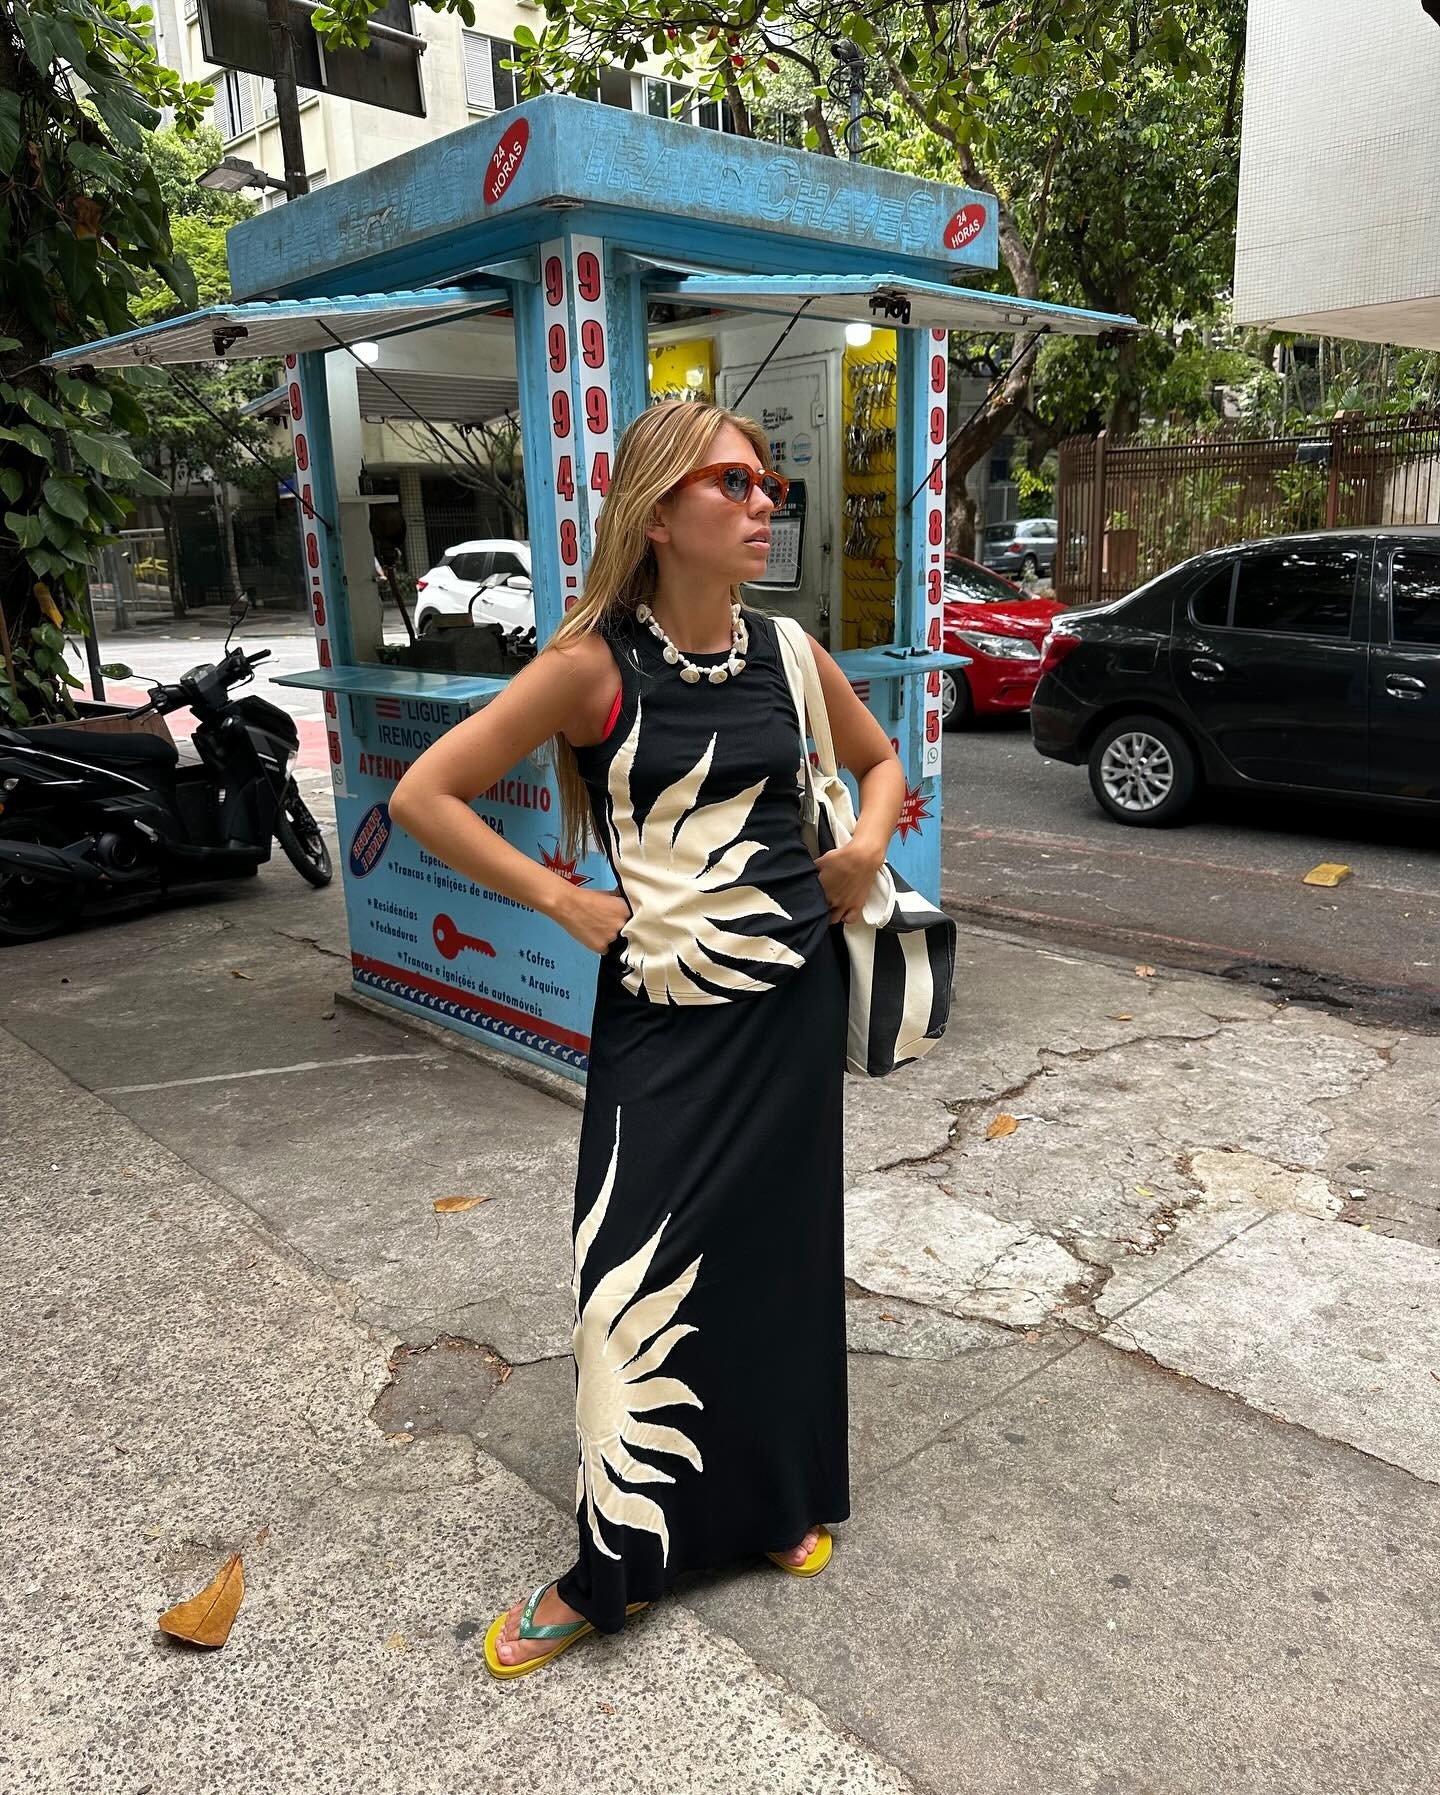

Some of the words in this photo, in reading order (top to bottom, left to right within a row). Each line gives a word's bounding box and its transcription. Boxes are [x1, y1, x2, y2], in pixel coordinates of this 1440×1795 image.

[493, 145, 506, 169] 24
[491, 141, 523, 200] HORAS
[956, 209, 967, 227] 24
[951, 218, 981, 249] HORAS
[378, 724, 432, 750] IREMOS
[426, 873, 432, 883] e
[469, 882, 481, 897] de
[373, 897, 418, 921] Residências
[375, 919, 418, 944] Fechaduras
[526, 949, 555, 970] Cofres
[435, 966, 442, 976] e
[442, 965, 477, 990] ignições
[478, 981, 491, 996] de
[491, 987, 543, 1017] automóveis
[529, 975, 570, 1000] Arquivos
